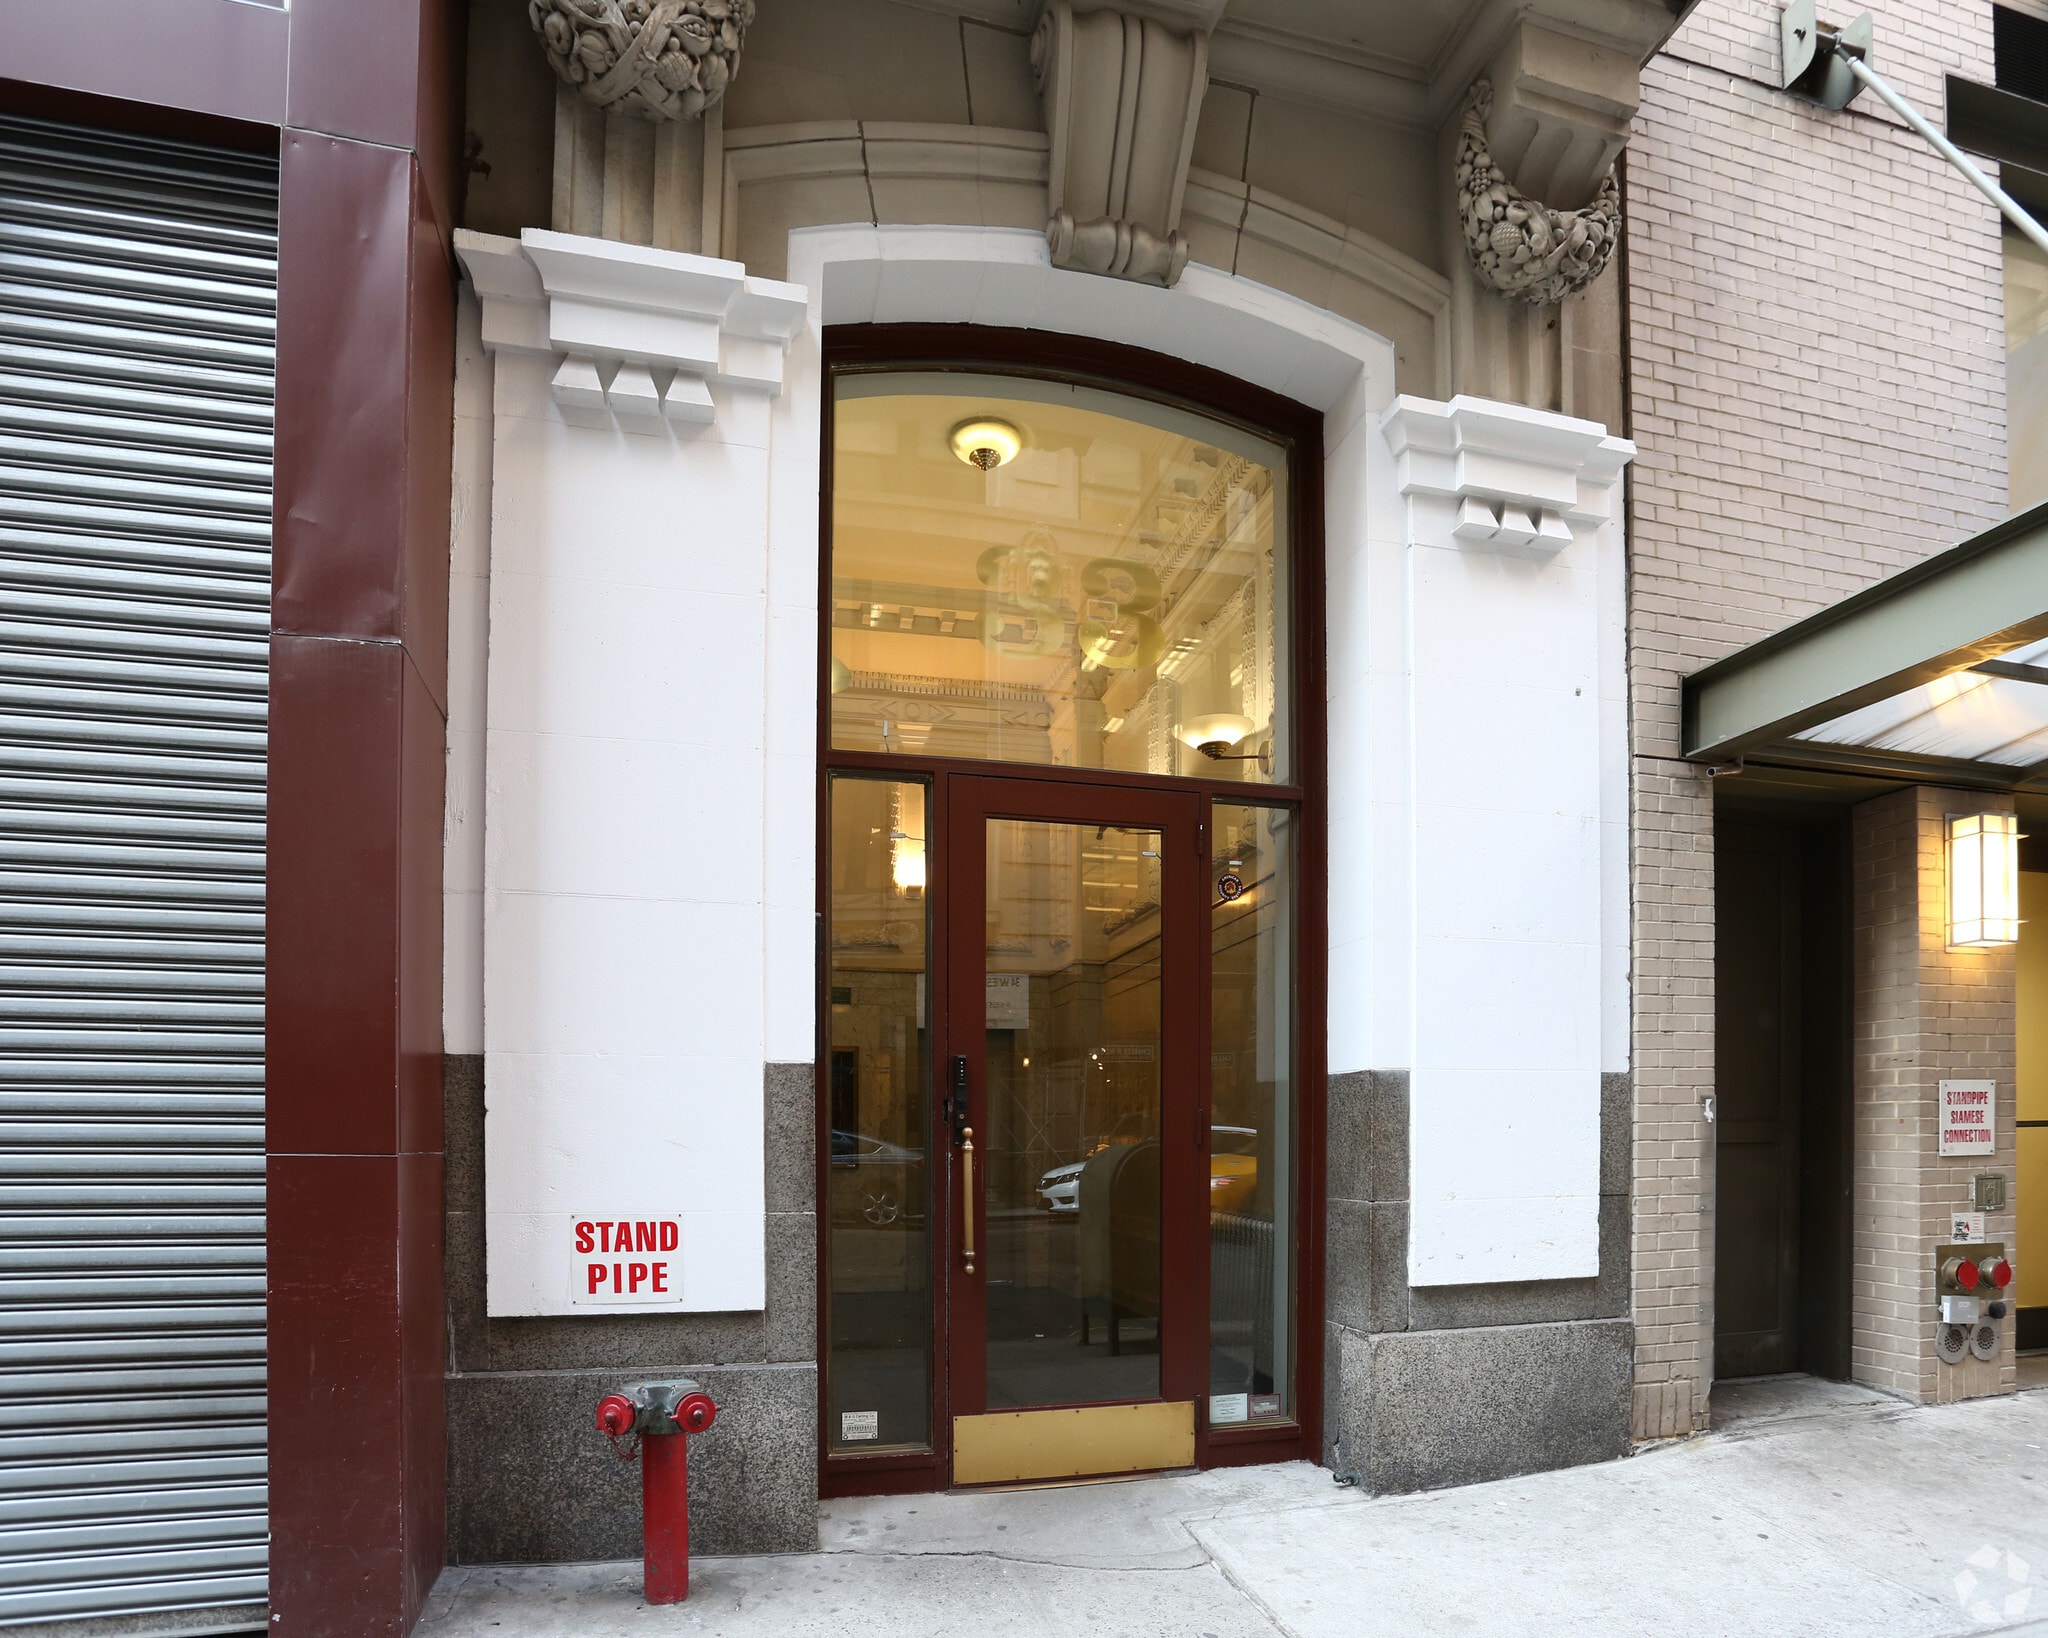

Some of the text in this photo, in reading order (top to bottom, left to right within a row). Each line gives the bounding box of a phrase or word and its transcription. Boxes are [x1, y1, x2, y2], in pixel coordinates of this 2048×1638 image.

[975, 544, 1166, 670] 33
[1946, 1091, 1988, 1105] STANDPIPE
[1951, 1110, 1985, 1124] SIAMESE
[1944, 1129, 1991, 1143] CONNECTION
[575, 1221, 679, 1254] STAND
[587, 1262, 668, 1294] PIPE
